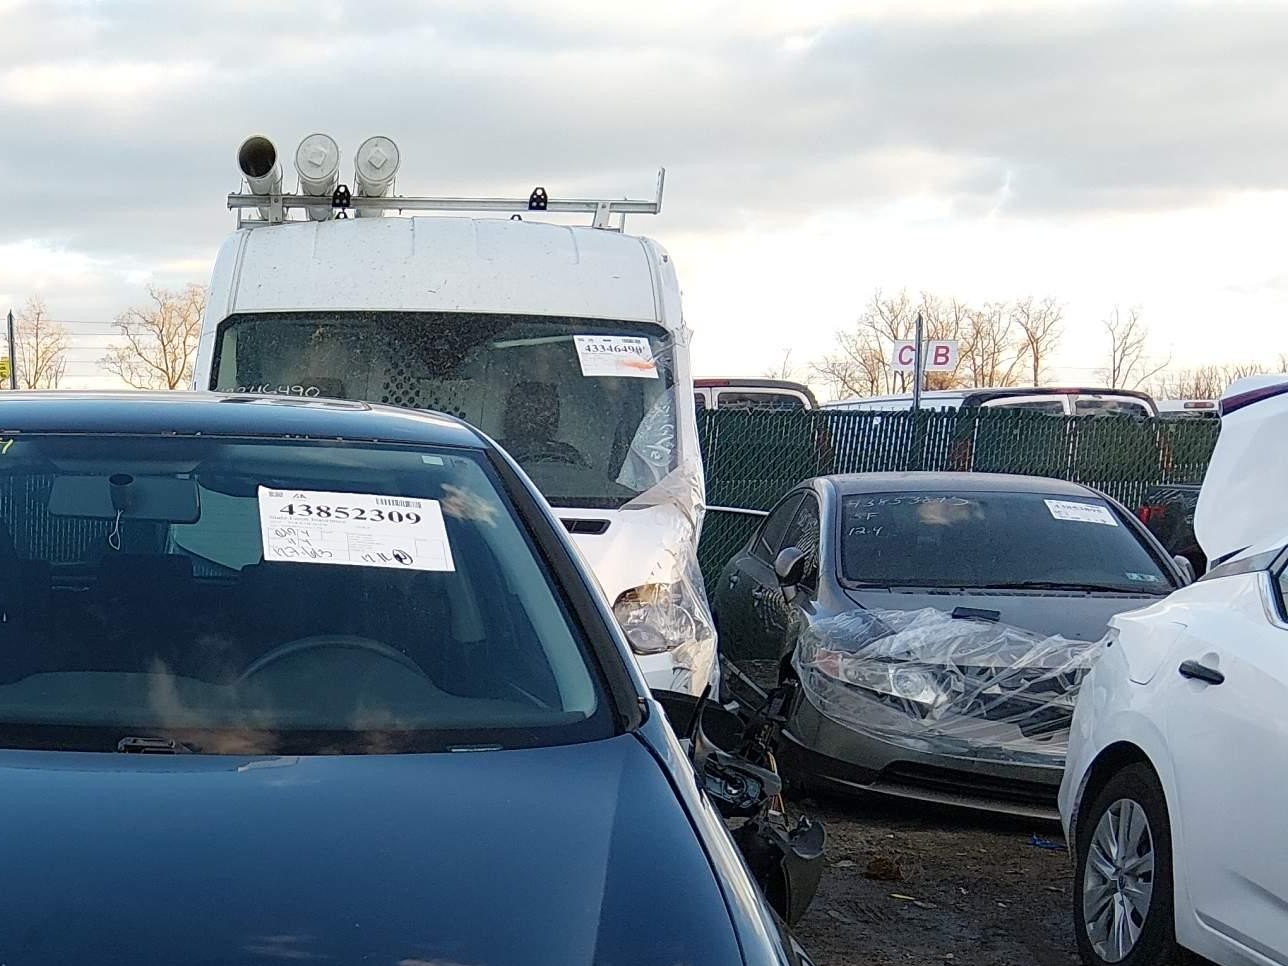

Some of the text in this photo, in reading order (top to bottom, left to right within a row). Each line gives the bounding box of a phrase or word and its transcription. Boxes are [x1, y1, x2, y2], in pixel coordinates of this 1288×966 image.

[898, 345, 916, 366] C
[933, 345, 950, 366] B
[279, 502, 422, 526] 43852309
